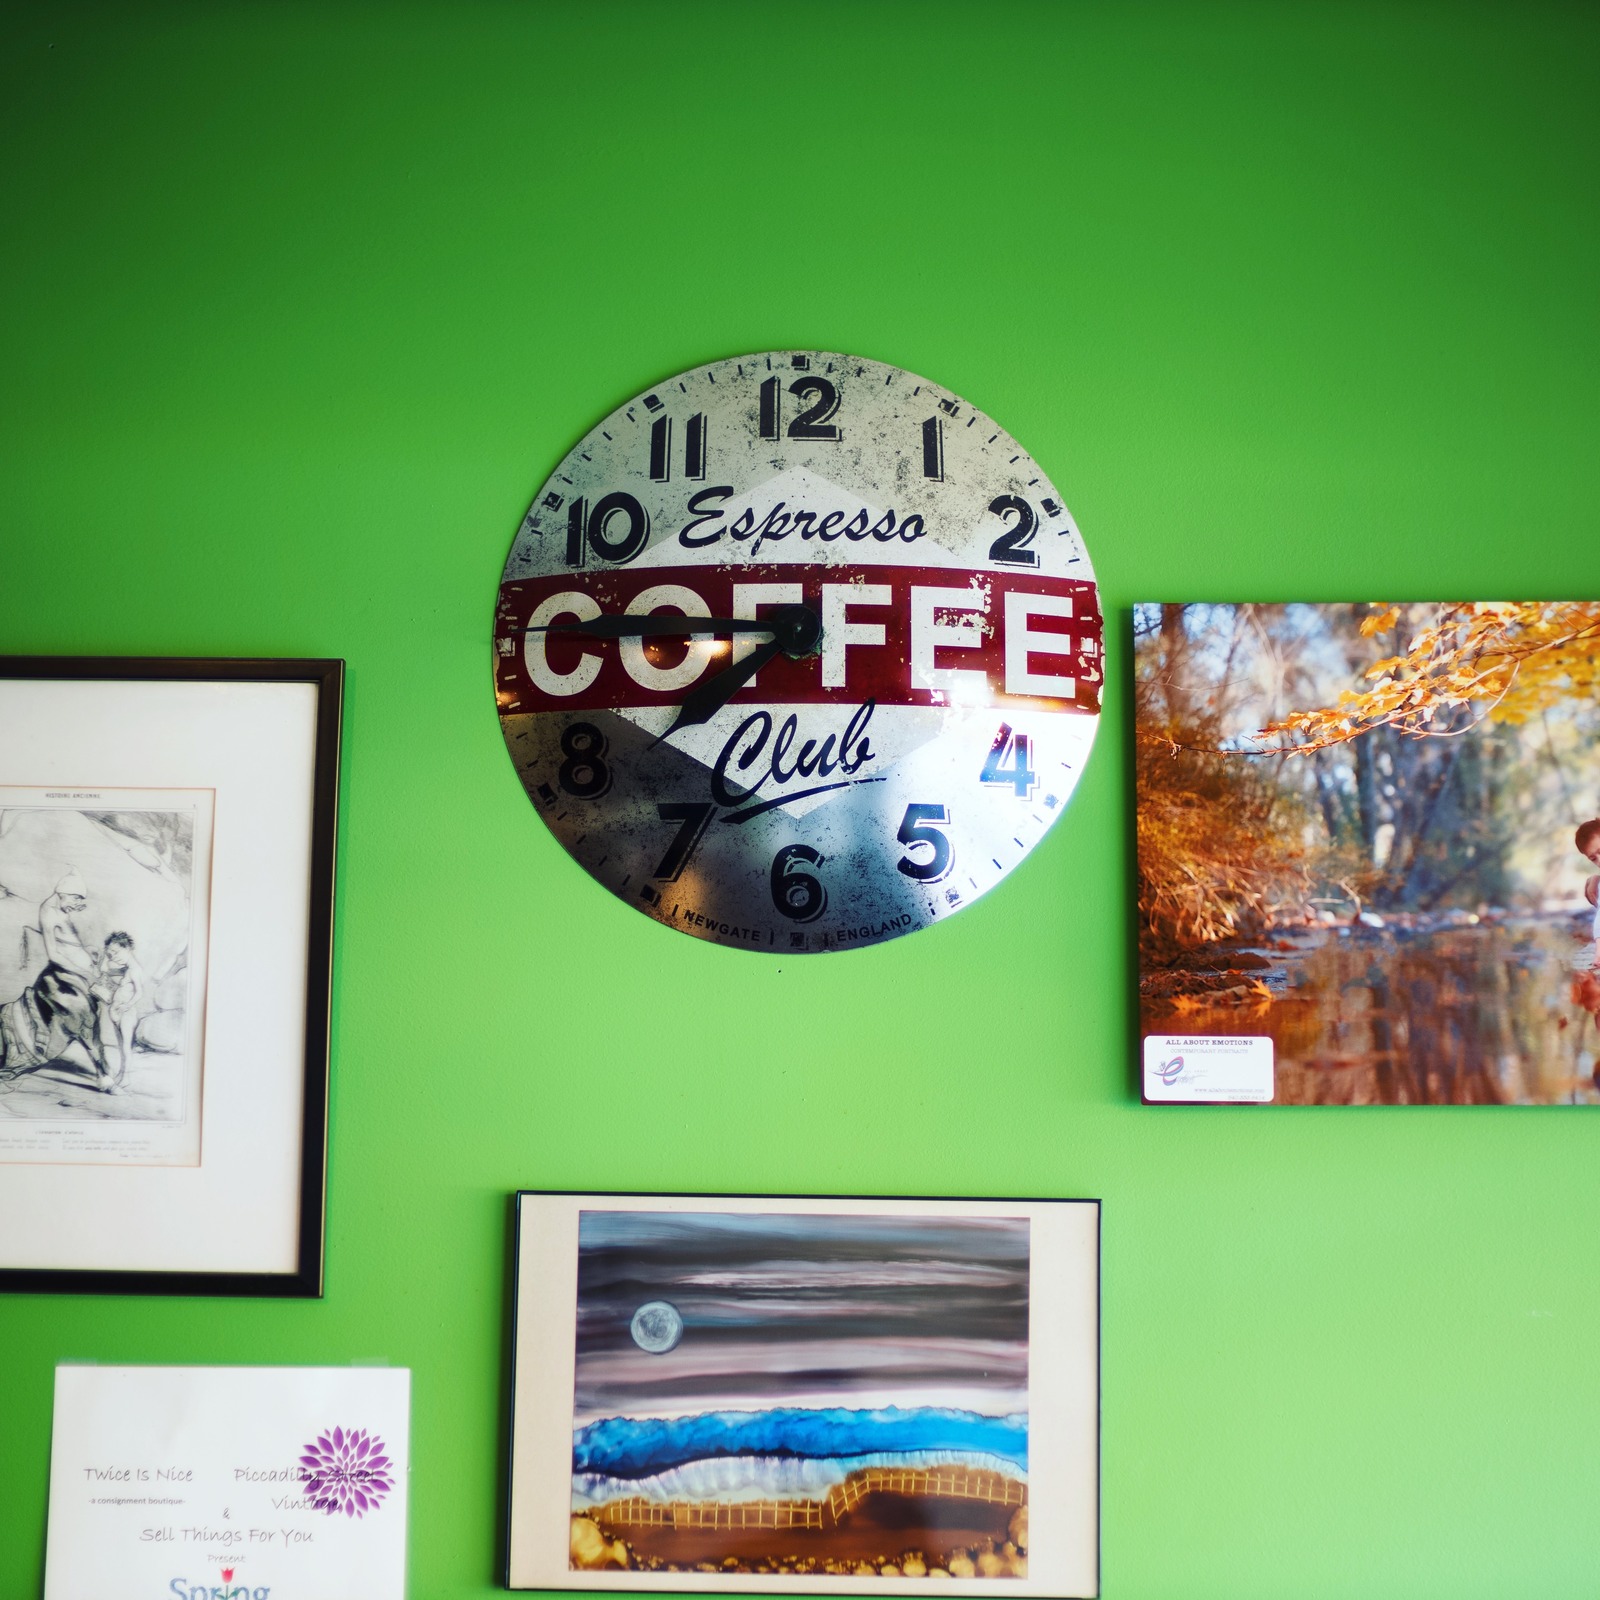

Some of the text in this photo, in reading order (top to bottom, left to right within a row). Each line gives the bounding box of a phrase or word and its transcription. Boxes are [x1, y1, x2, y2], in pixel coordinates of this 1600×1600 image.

[759, 376, 841, 441] 12
[650, 412, 707, 482] 11
[922, 416, 944, 482] 1
[566, 491, 650, 567] 10
[678, 486, 928, 557] Espresso
[987, 495, 1039, 568] 2
[524, 583, 1075, 698] COFFEE
[559, 722, 609, 799] 8
[711, 699, 876, 808] Club
[979, 722, 1039, 801] 4
[652, 802, 717, 882] 7
[896, 803, 952, 884] 5
[770, 845, 828, 924] 6
[684, 910, 761, 942] NEWGATE
[837, 913, 912, 942] ENGLAND
[84, 1468, 193, 1482] Twice Is Nice
[97, 1497, 146, 1506] consignment
[234, 1466, 320, 1490] Piccadilly
[271, 1495, 340, 1516] Vintage
[139, 1528, 314, 1548] Sell Things For You
[207, 1554, 246, 1563] Present
